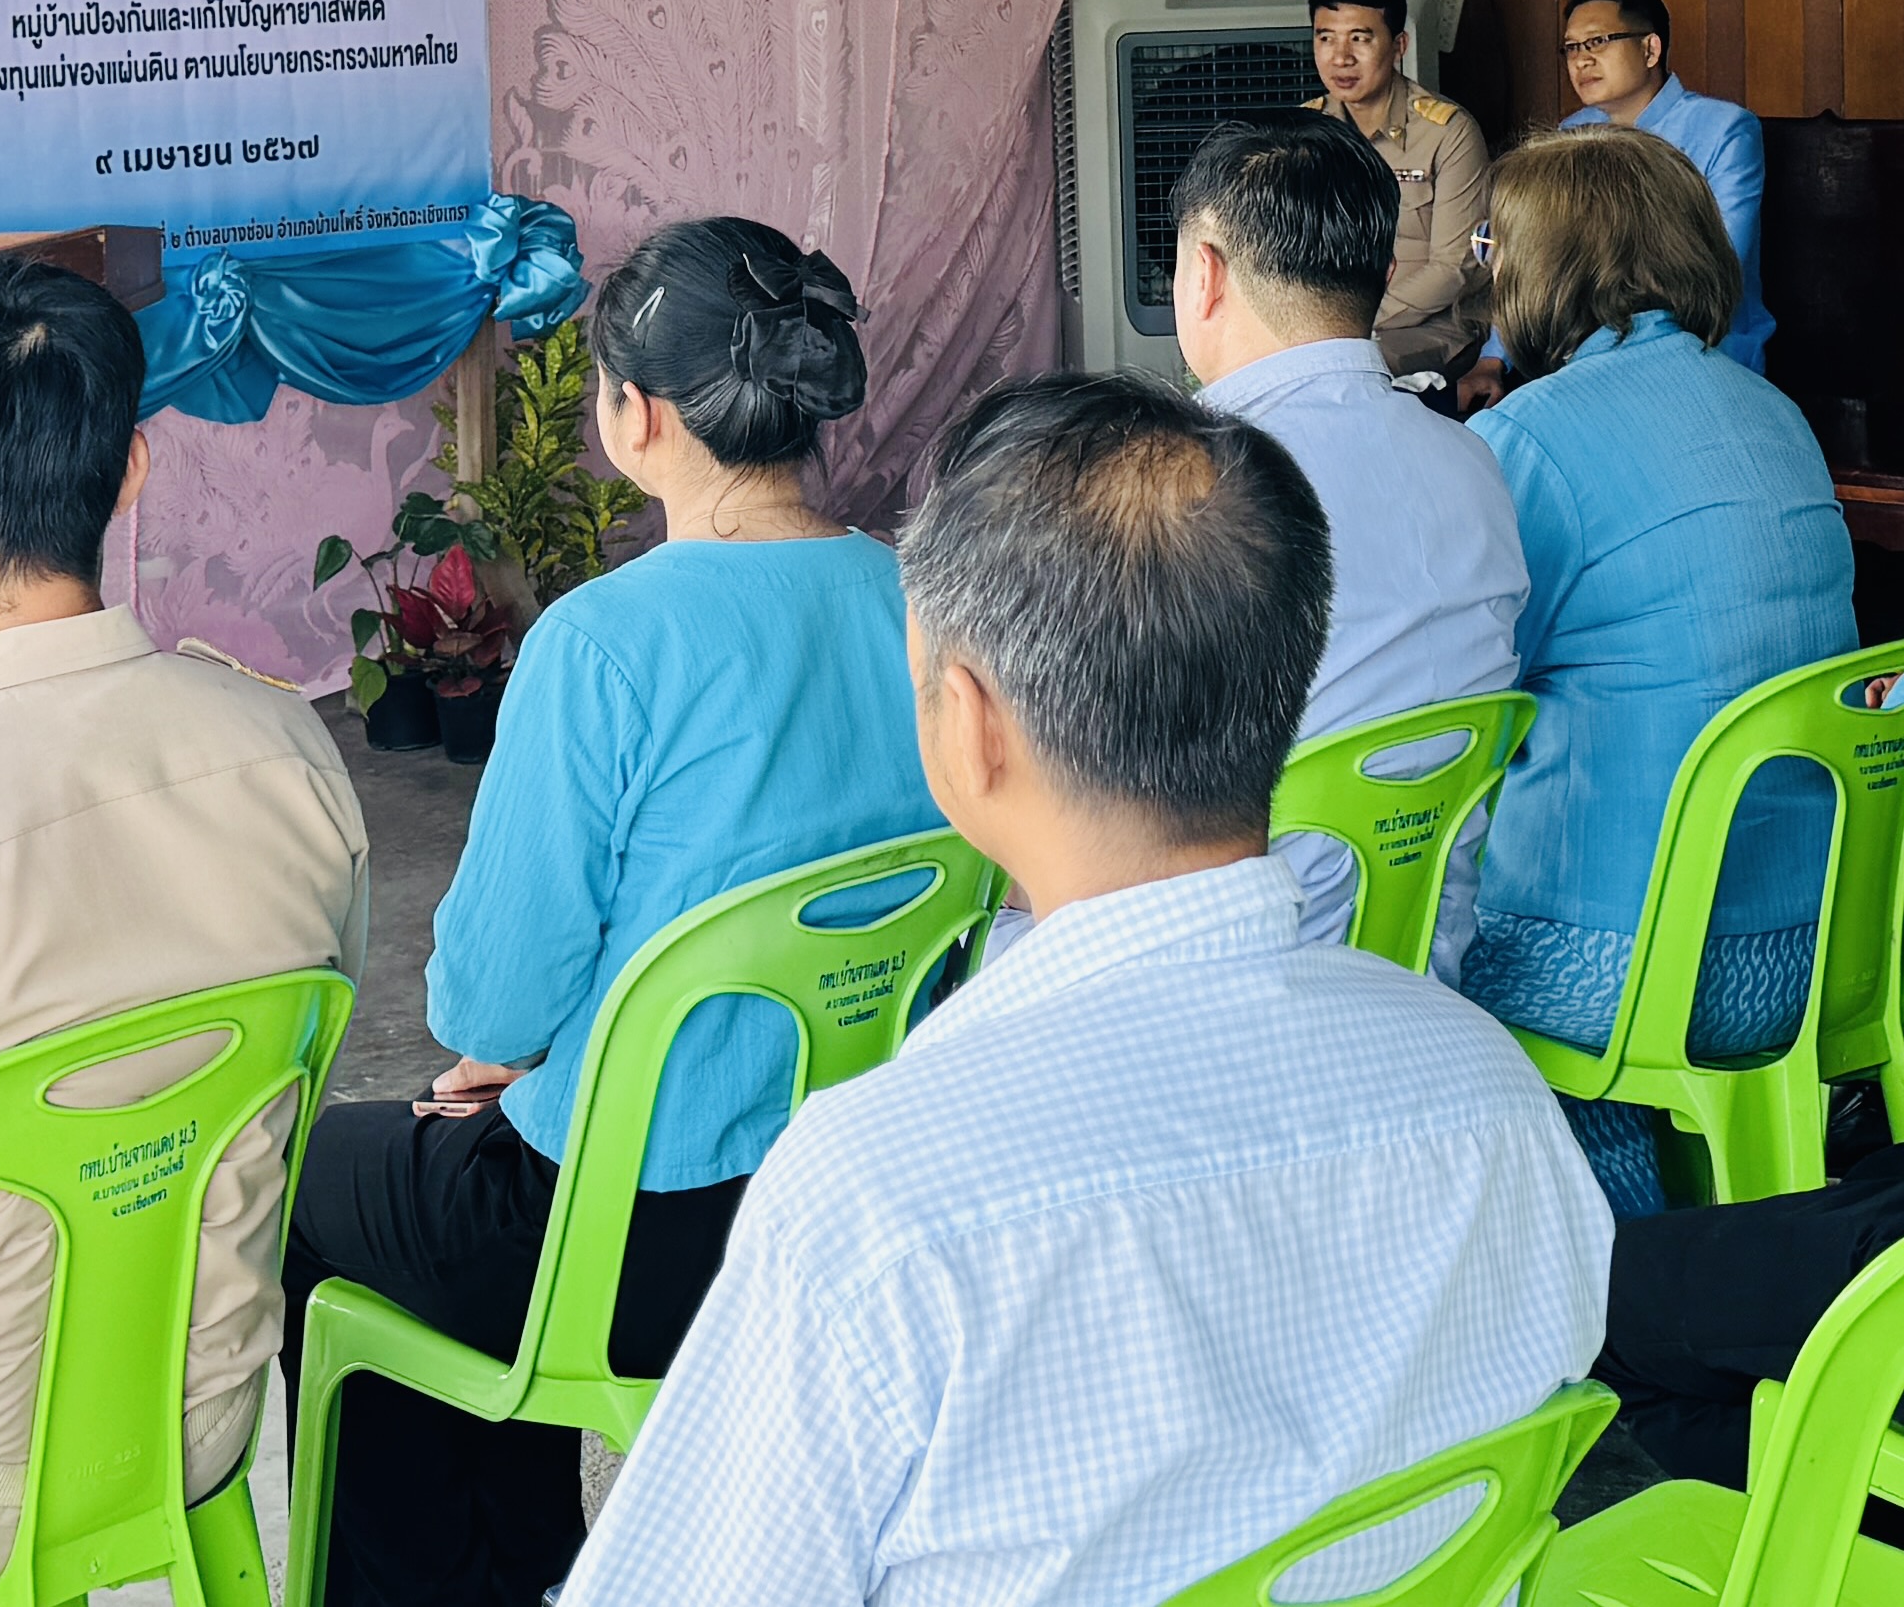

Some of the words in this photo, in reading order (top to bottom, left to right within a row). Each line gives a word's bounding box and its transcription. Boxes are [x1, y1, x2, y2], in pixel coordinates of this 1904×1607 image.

[184, 34, 459, 80] ตามนโยบายกระทรวงมหาดไทย
[95, 148, 113, 175] ๙
[123, 139, 232, 174] เมษายน
[242, 133, 321, 164] ๒๕๖๗
